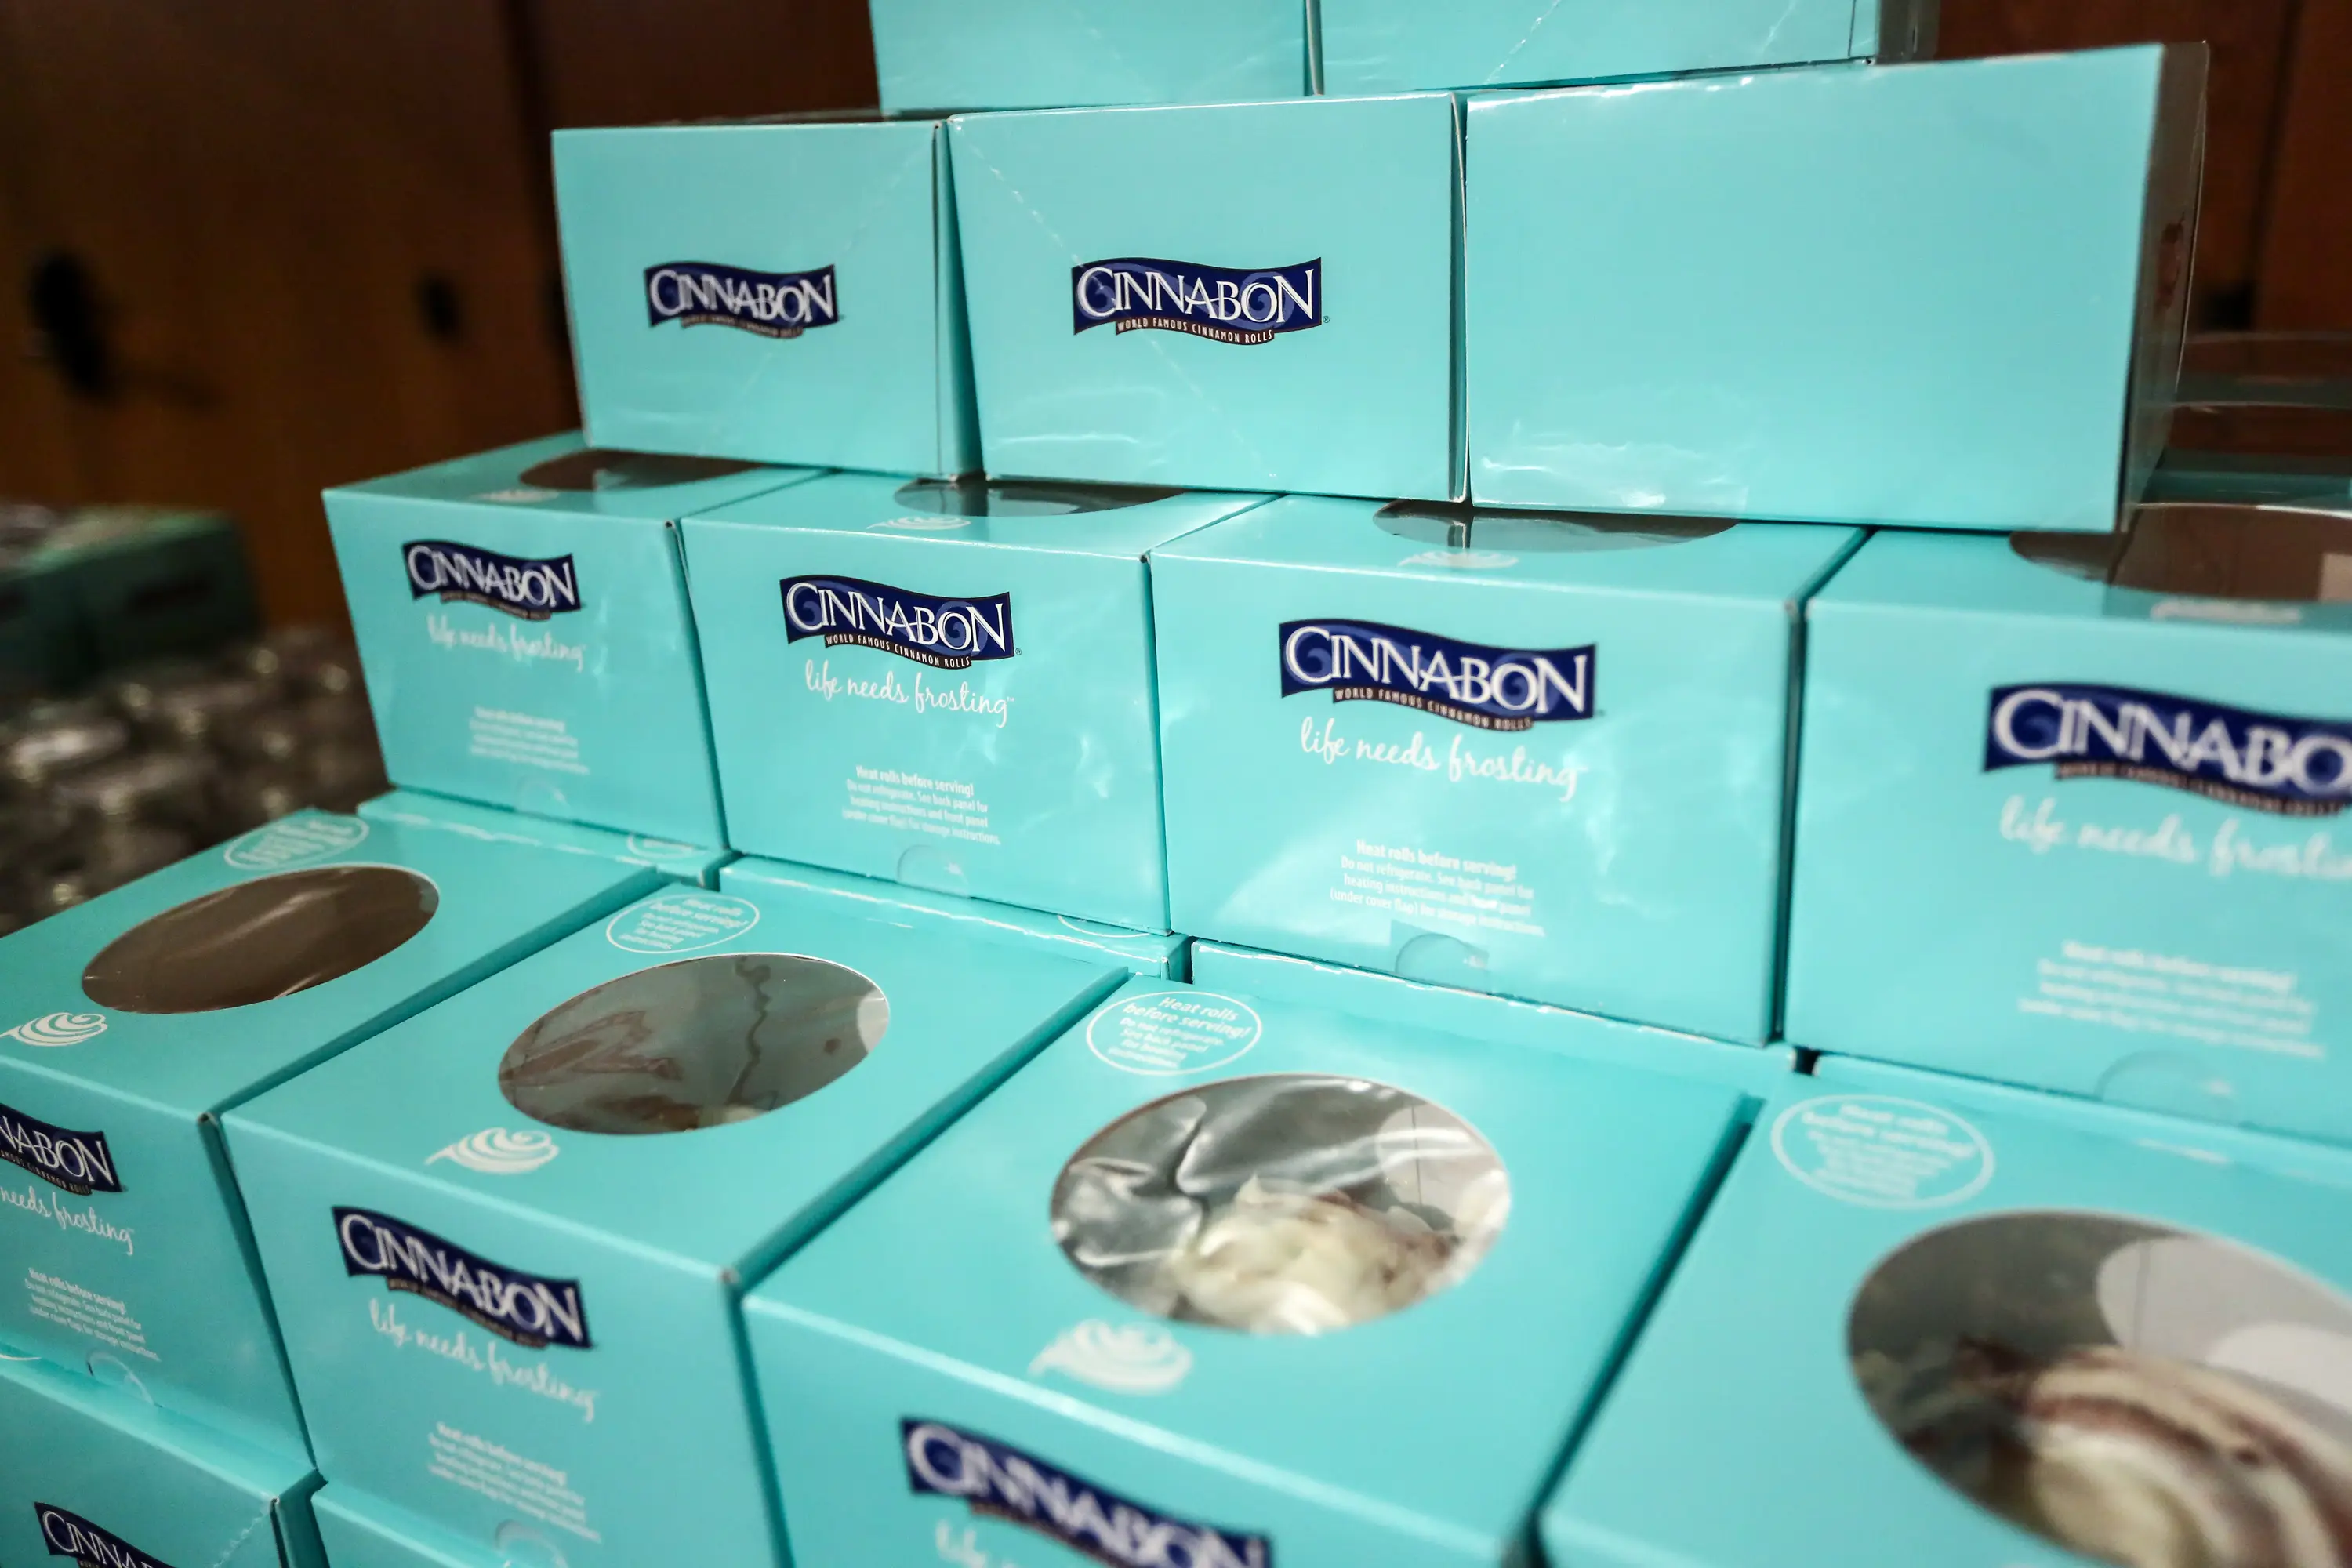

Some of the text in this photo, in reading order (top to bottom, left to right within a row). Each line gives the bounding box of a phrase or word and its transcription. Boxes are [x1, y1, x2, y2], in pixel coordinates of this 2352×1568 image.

[650, 269, 833, 323] CINNABON
[1077, 267, 1314, 324] CINNABON
[1117, 318, 1273, 343] WORLD FAMOUS CINNAMON ROLLS
[408, 544, 576, 608] CINNABON
[786, 582, 1007, 652] CINNABON
[826, 633, 971, 668] WORLD FAMOUS CINNAMON ROLLS
[1286, 626, 1588, 713] CINNABON
[804, 659, 842, 701] life
[847, 670, 909, 703] needs
[1378, 688, 1423, 709] FAMOUS
[1300, 716, 1351, 765] life
[1356, 731, 1441, 771] needs
[1123, 1002, 1178, 1023] before
[1159, 996, 1240, 1022] Heat rolls
[340, 1213, 583, 1343] CINNABON
